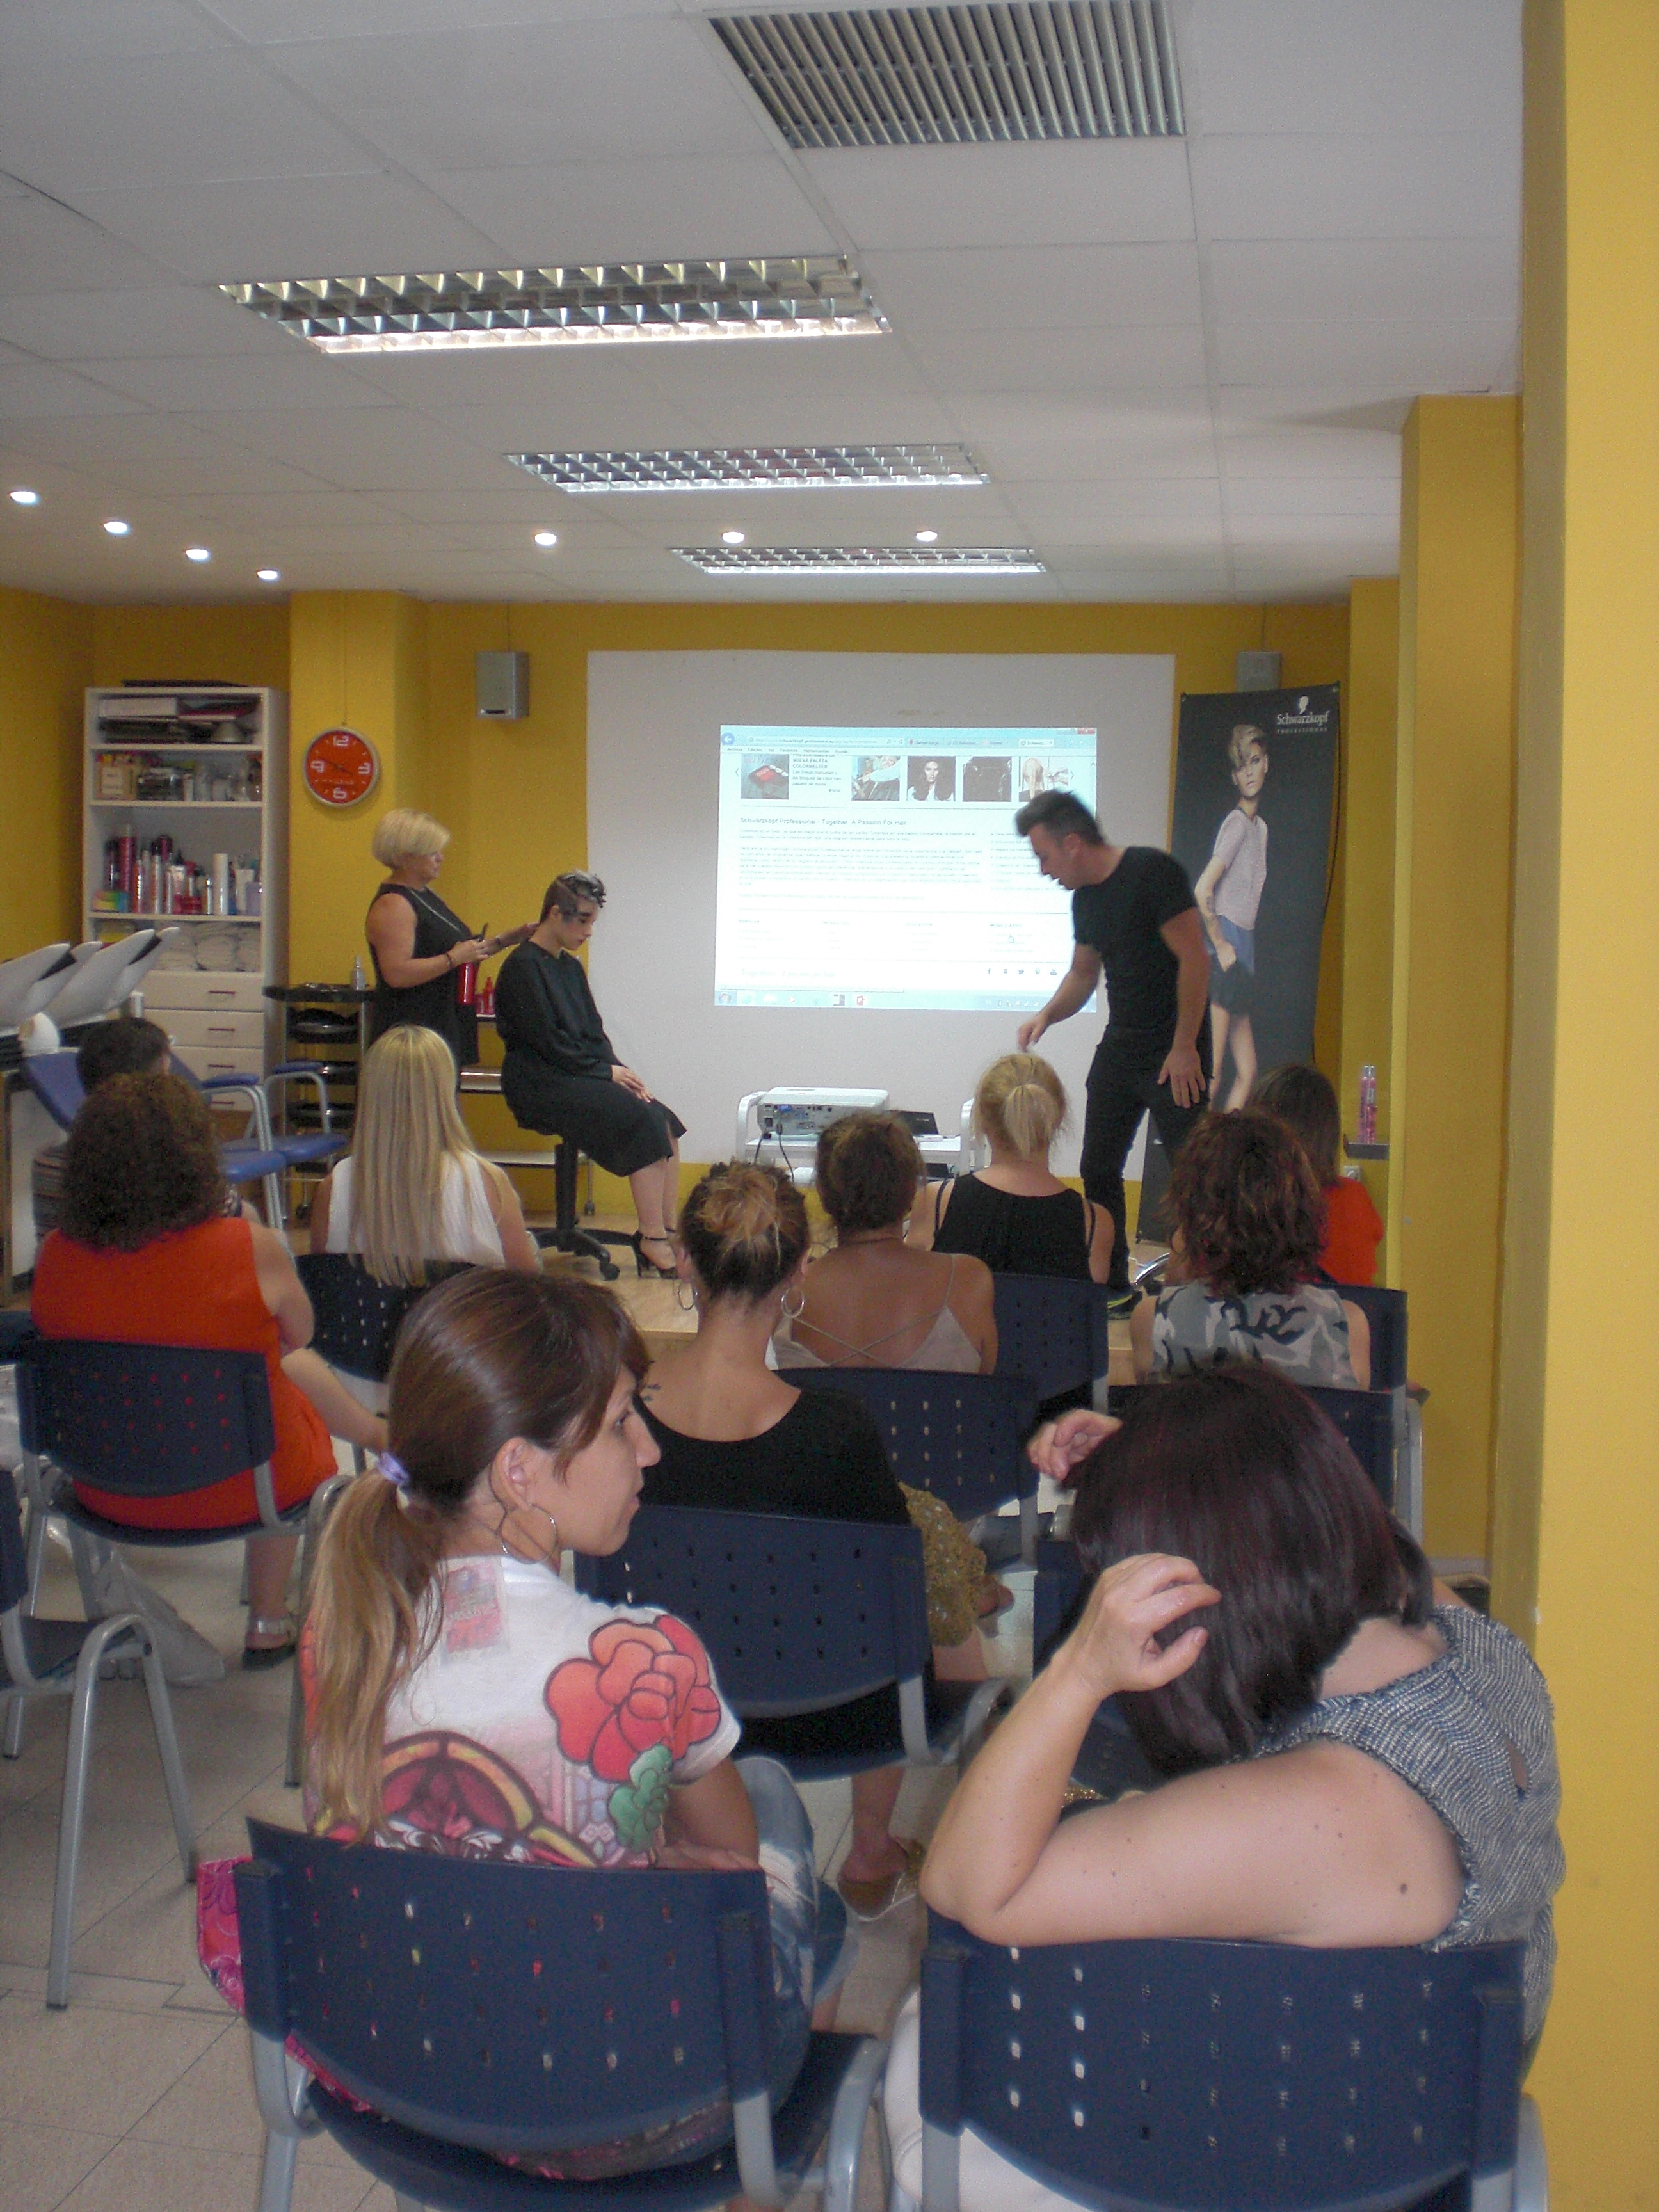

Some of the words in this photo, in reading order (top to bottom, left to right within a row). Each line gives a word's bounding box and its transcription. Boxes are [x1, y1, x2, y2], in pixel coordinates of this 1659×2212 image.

[1277, 710, 1329, 726] Schwarzkopf
[333, 735, 349, 747] 12
[310, 760, 325, 773] 9
[357, 762, 371, 774] 3
[332, 787, 347, 800] 6
